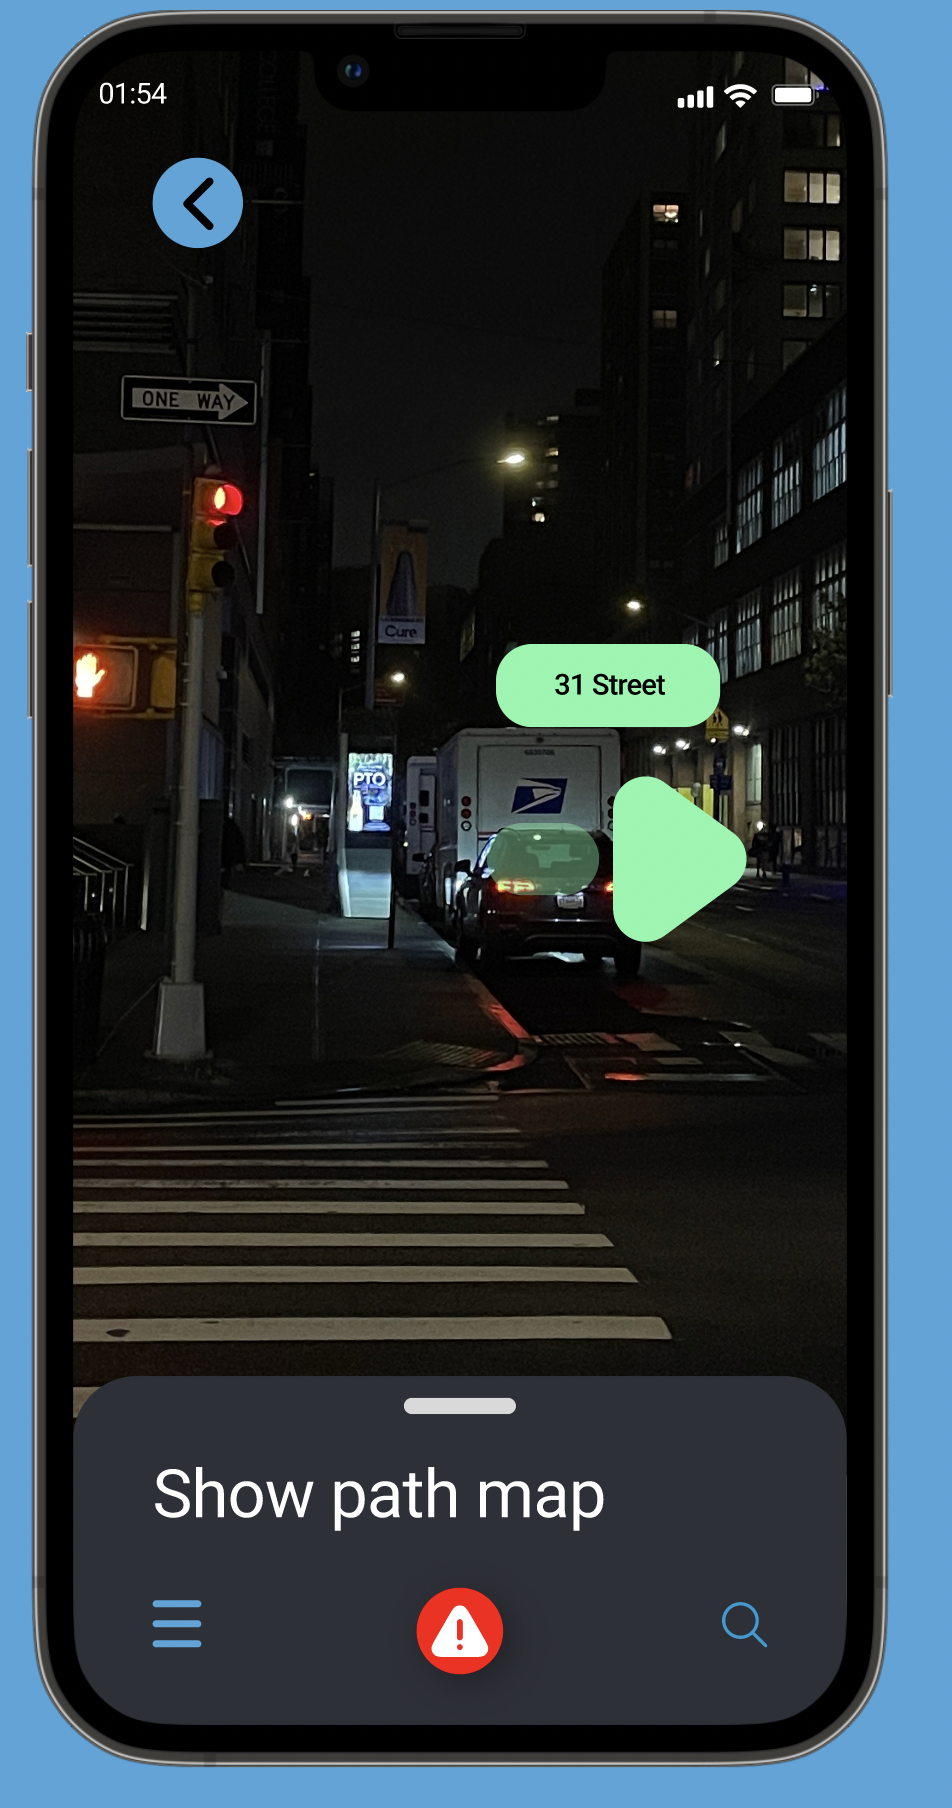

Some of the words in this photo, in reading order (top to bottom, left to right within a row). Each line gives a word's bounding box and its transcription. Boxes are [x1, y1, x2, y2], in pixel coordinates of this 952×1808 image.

[99, 82, 168, 106] 01:54
[142, 390, 180, 408] ONE
[197, 393, 236, 411] WAY
[384, 624, 418, 638] Cure
[554, 673, 582, 696] 31
[592, 672, 667, 697] Street
[353, 771, 387, 787] PTO
[154, 1466, 314, 1519] Show
[334, 1466, 457, 1532] path
[479, 1480, 605, 1532] map
